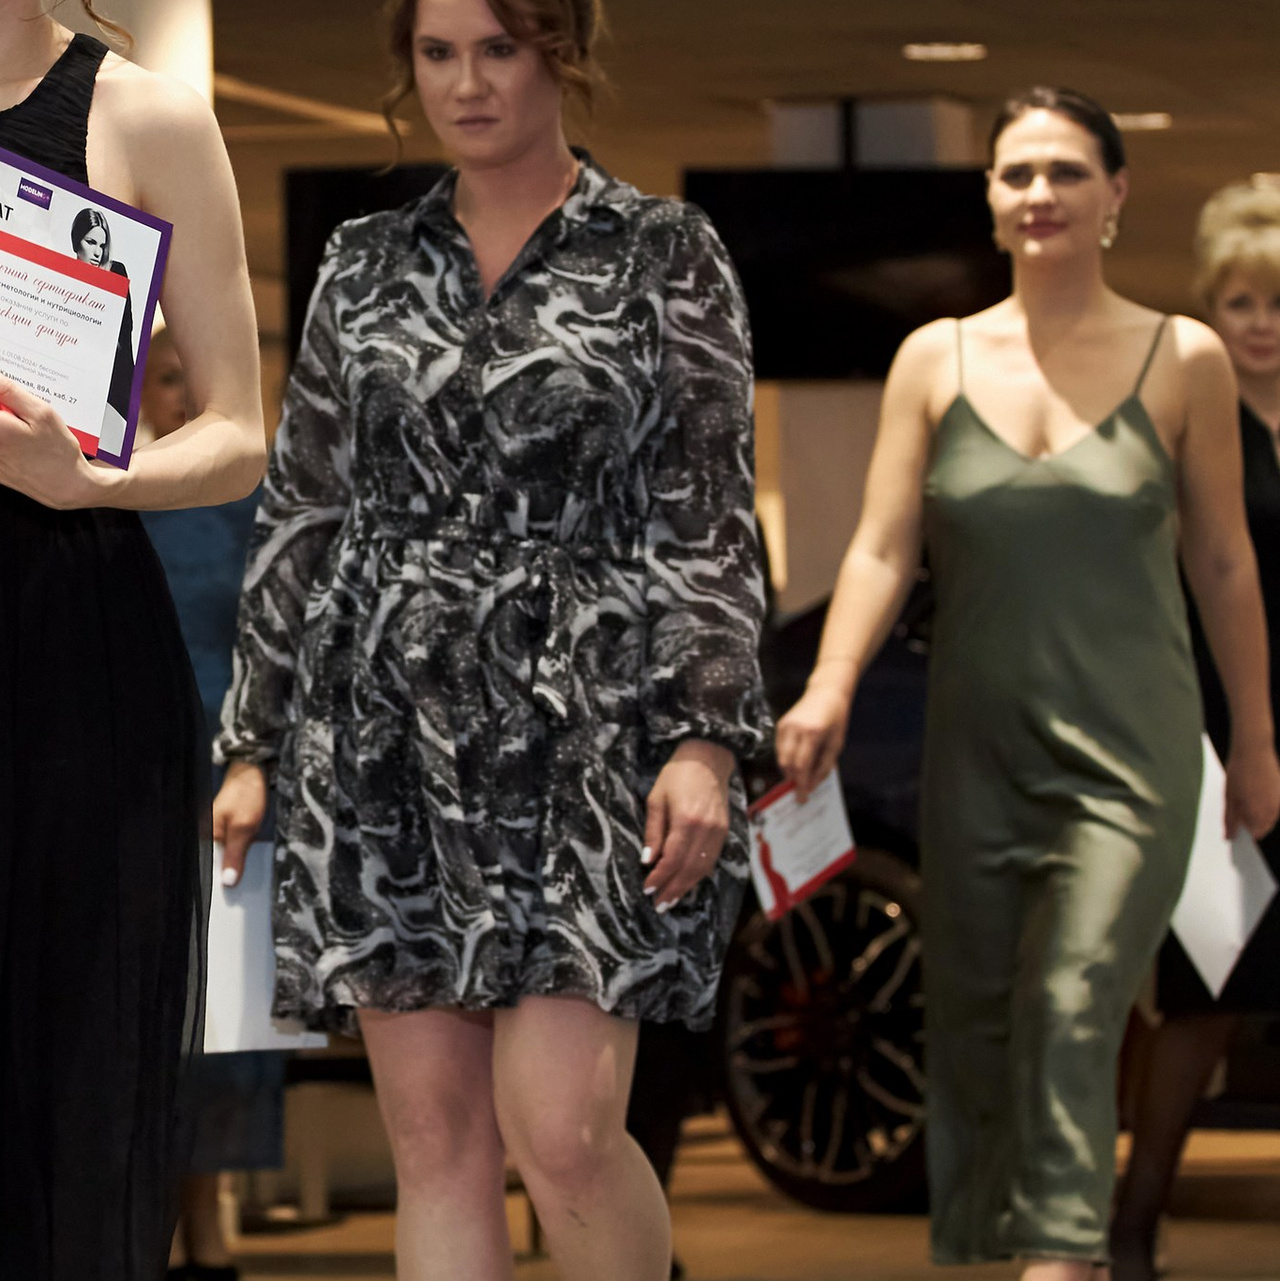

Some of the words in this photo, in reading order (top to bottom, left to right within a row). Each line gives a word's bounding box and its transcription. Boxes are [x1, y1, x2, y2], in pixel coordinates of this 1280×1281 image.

[0, 295, 33, 313] оказание
[34, 308, 59, 323] услуги
[60, 318, 68, 327] по
[47, 300, 102, 326] нутрициологии
[68, 396, 78, 405] 27
